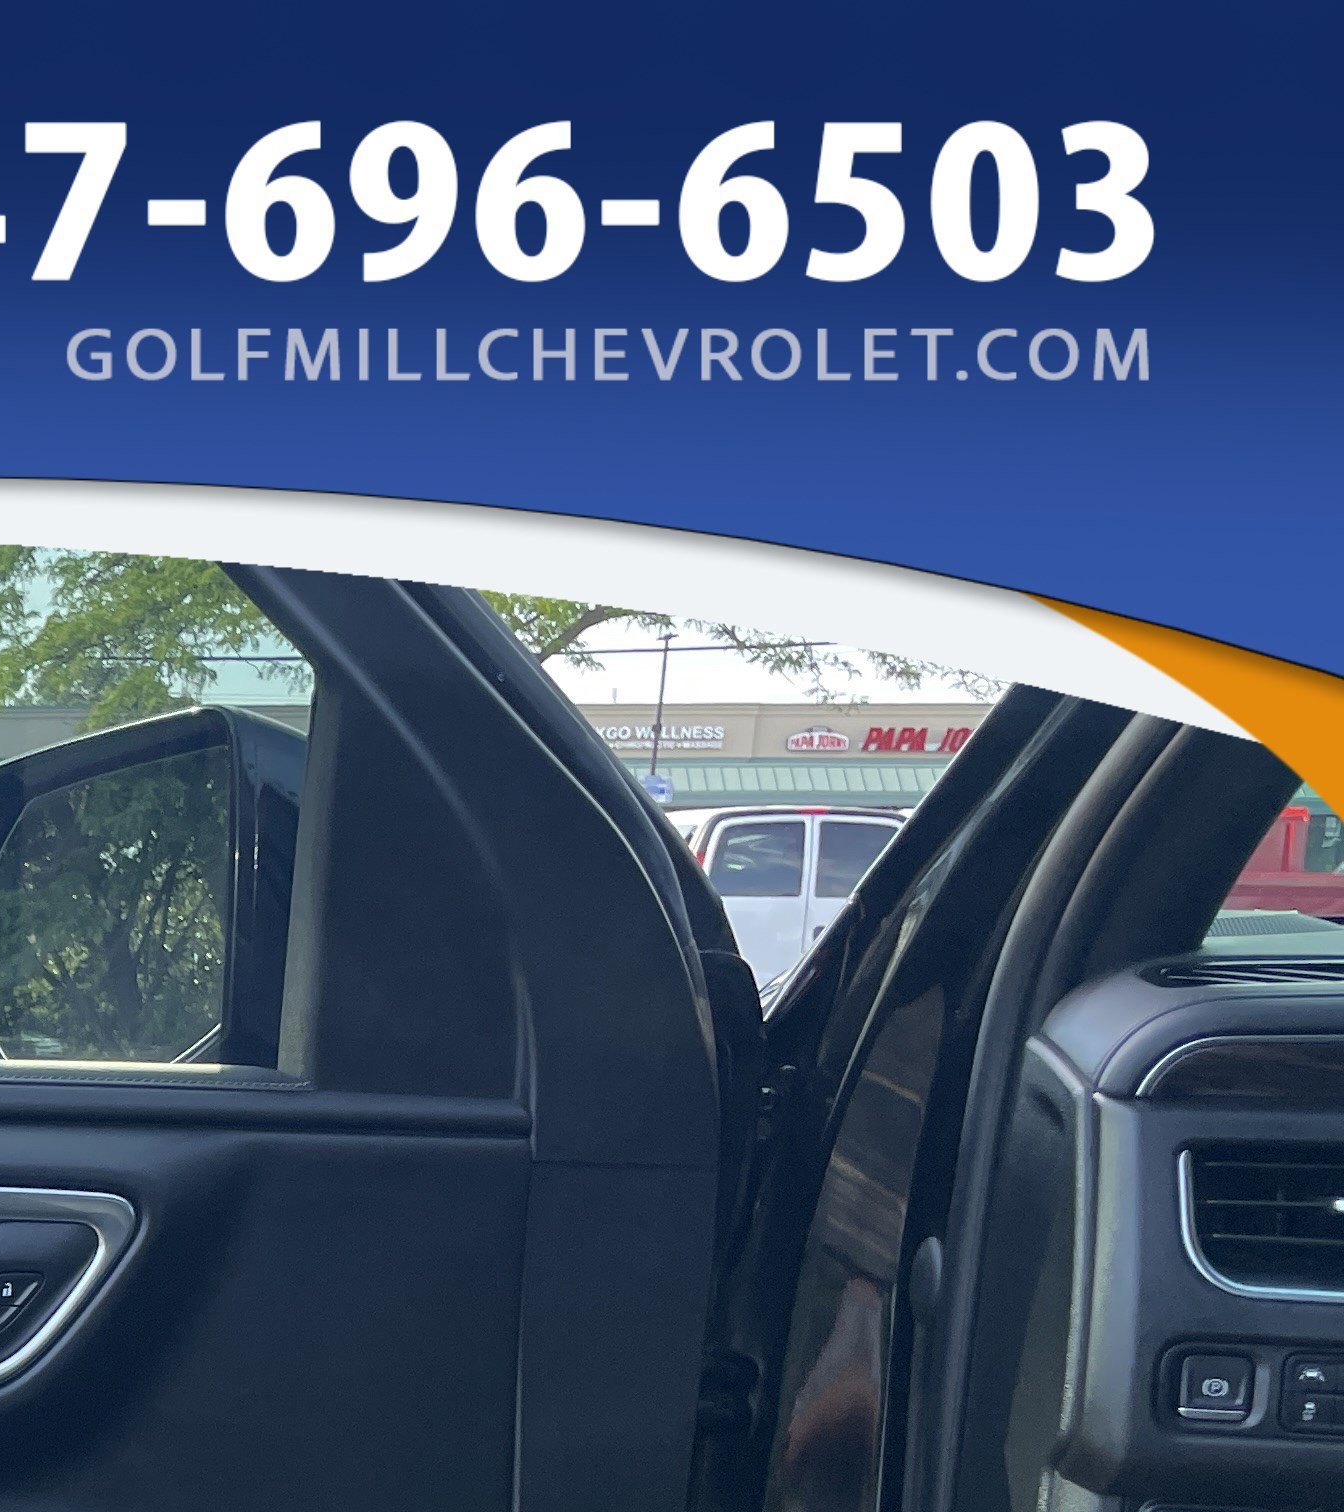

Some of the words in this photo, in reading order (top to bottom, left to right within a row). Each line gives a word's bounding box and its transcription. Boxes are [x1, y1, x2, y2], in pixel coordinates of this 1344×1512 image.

[635, 725, 724, 740] WLLNESS
[861, 727, 929, 752] PAPA
[937, 727, 976, 752] JO
